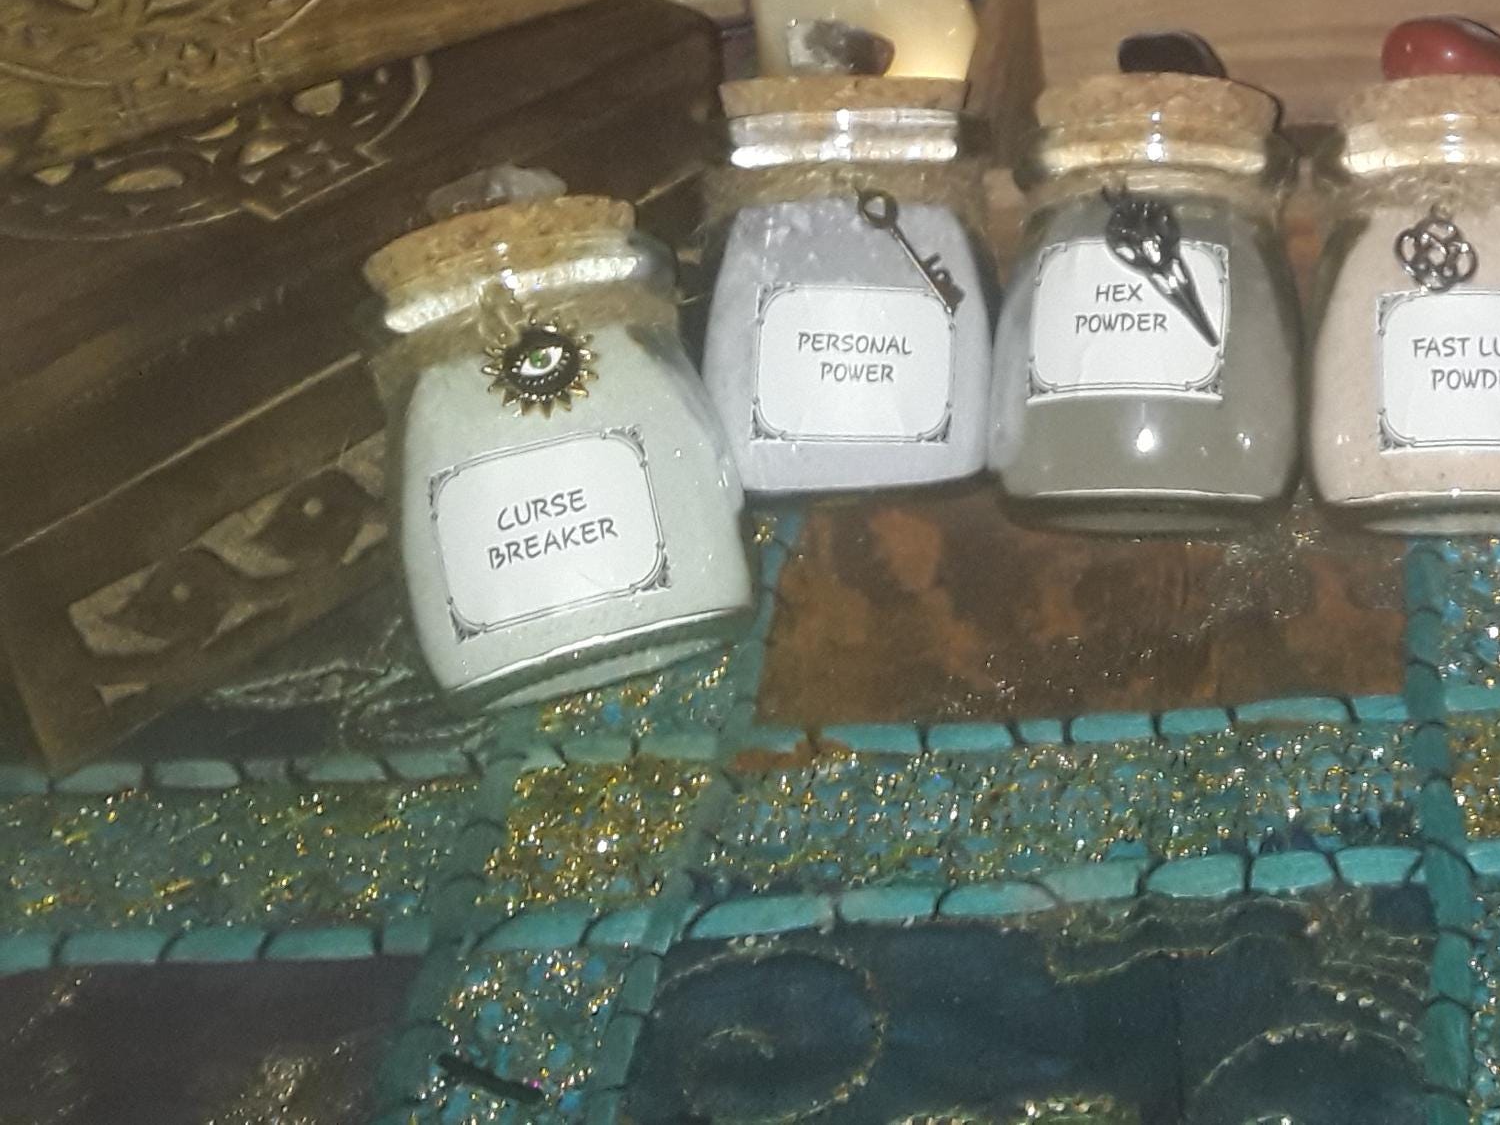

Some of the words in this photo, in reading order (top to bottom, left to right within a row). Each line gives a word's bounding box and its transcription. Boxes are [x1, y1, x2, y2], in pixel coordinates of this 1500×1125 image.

[1095, 283, 1144, 302] HEX
[1075, 312, 1169, 334] POWDER
[798, 331, 912, 355] PERSONAL
[1412, 336, 1470, 359] FAST
[820, 361, 895, 383] POWER
[497, 488, 588, 531] CURSE
[486, 516, 619, 571] BREAKER
